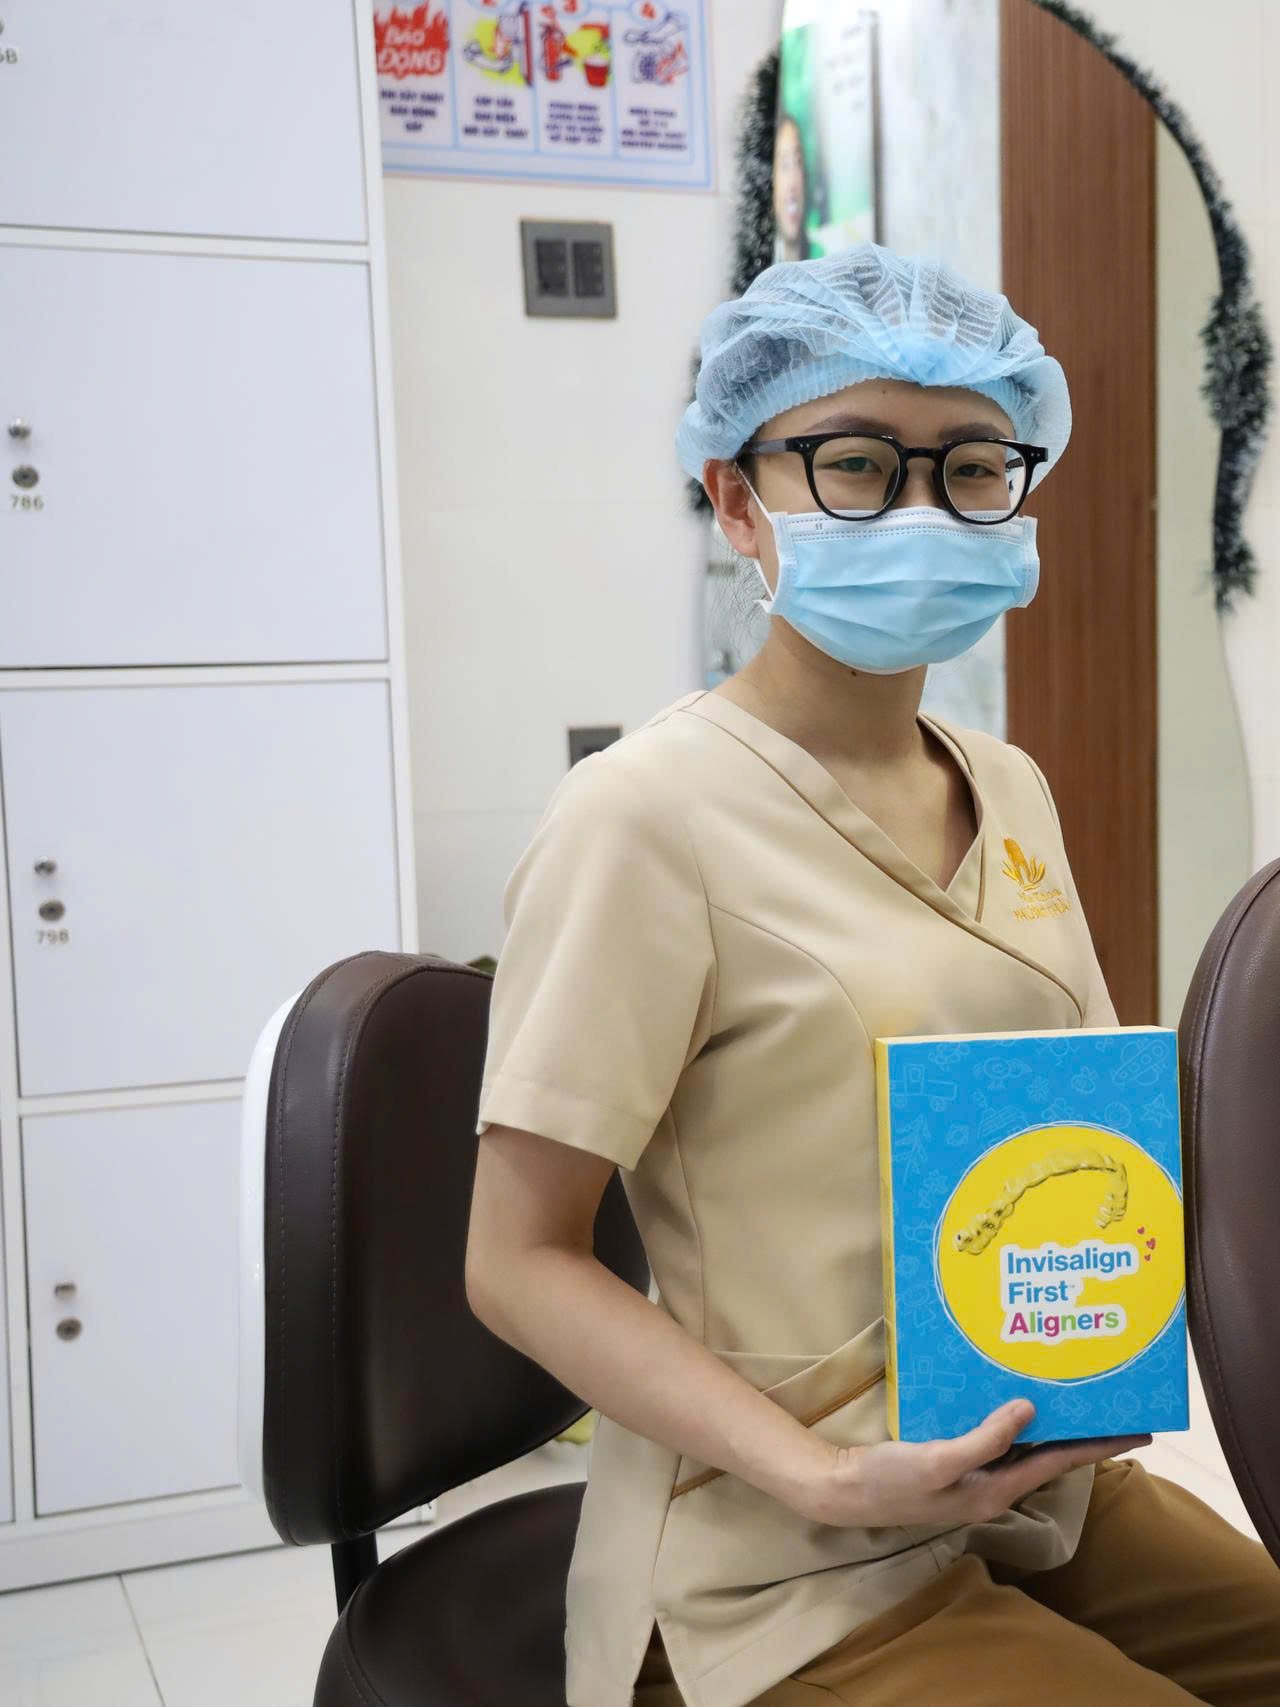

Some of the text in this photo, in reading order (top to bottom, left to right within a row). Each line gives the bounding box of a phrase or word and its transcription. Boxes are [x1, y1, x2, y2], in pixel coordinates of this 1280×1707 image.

[1007, 1247, 1132, 1274] Invisalign
[1009, 1280, 1069, 1304] First
[1009, 1311, 1120, 1337] Aligners
